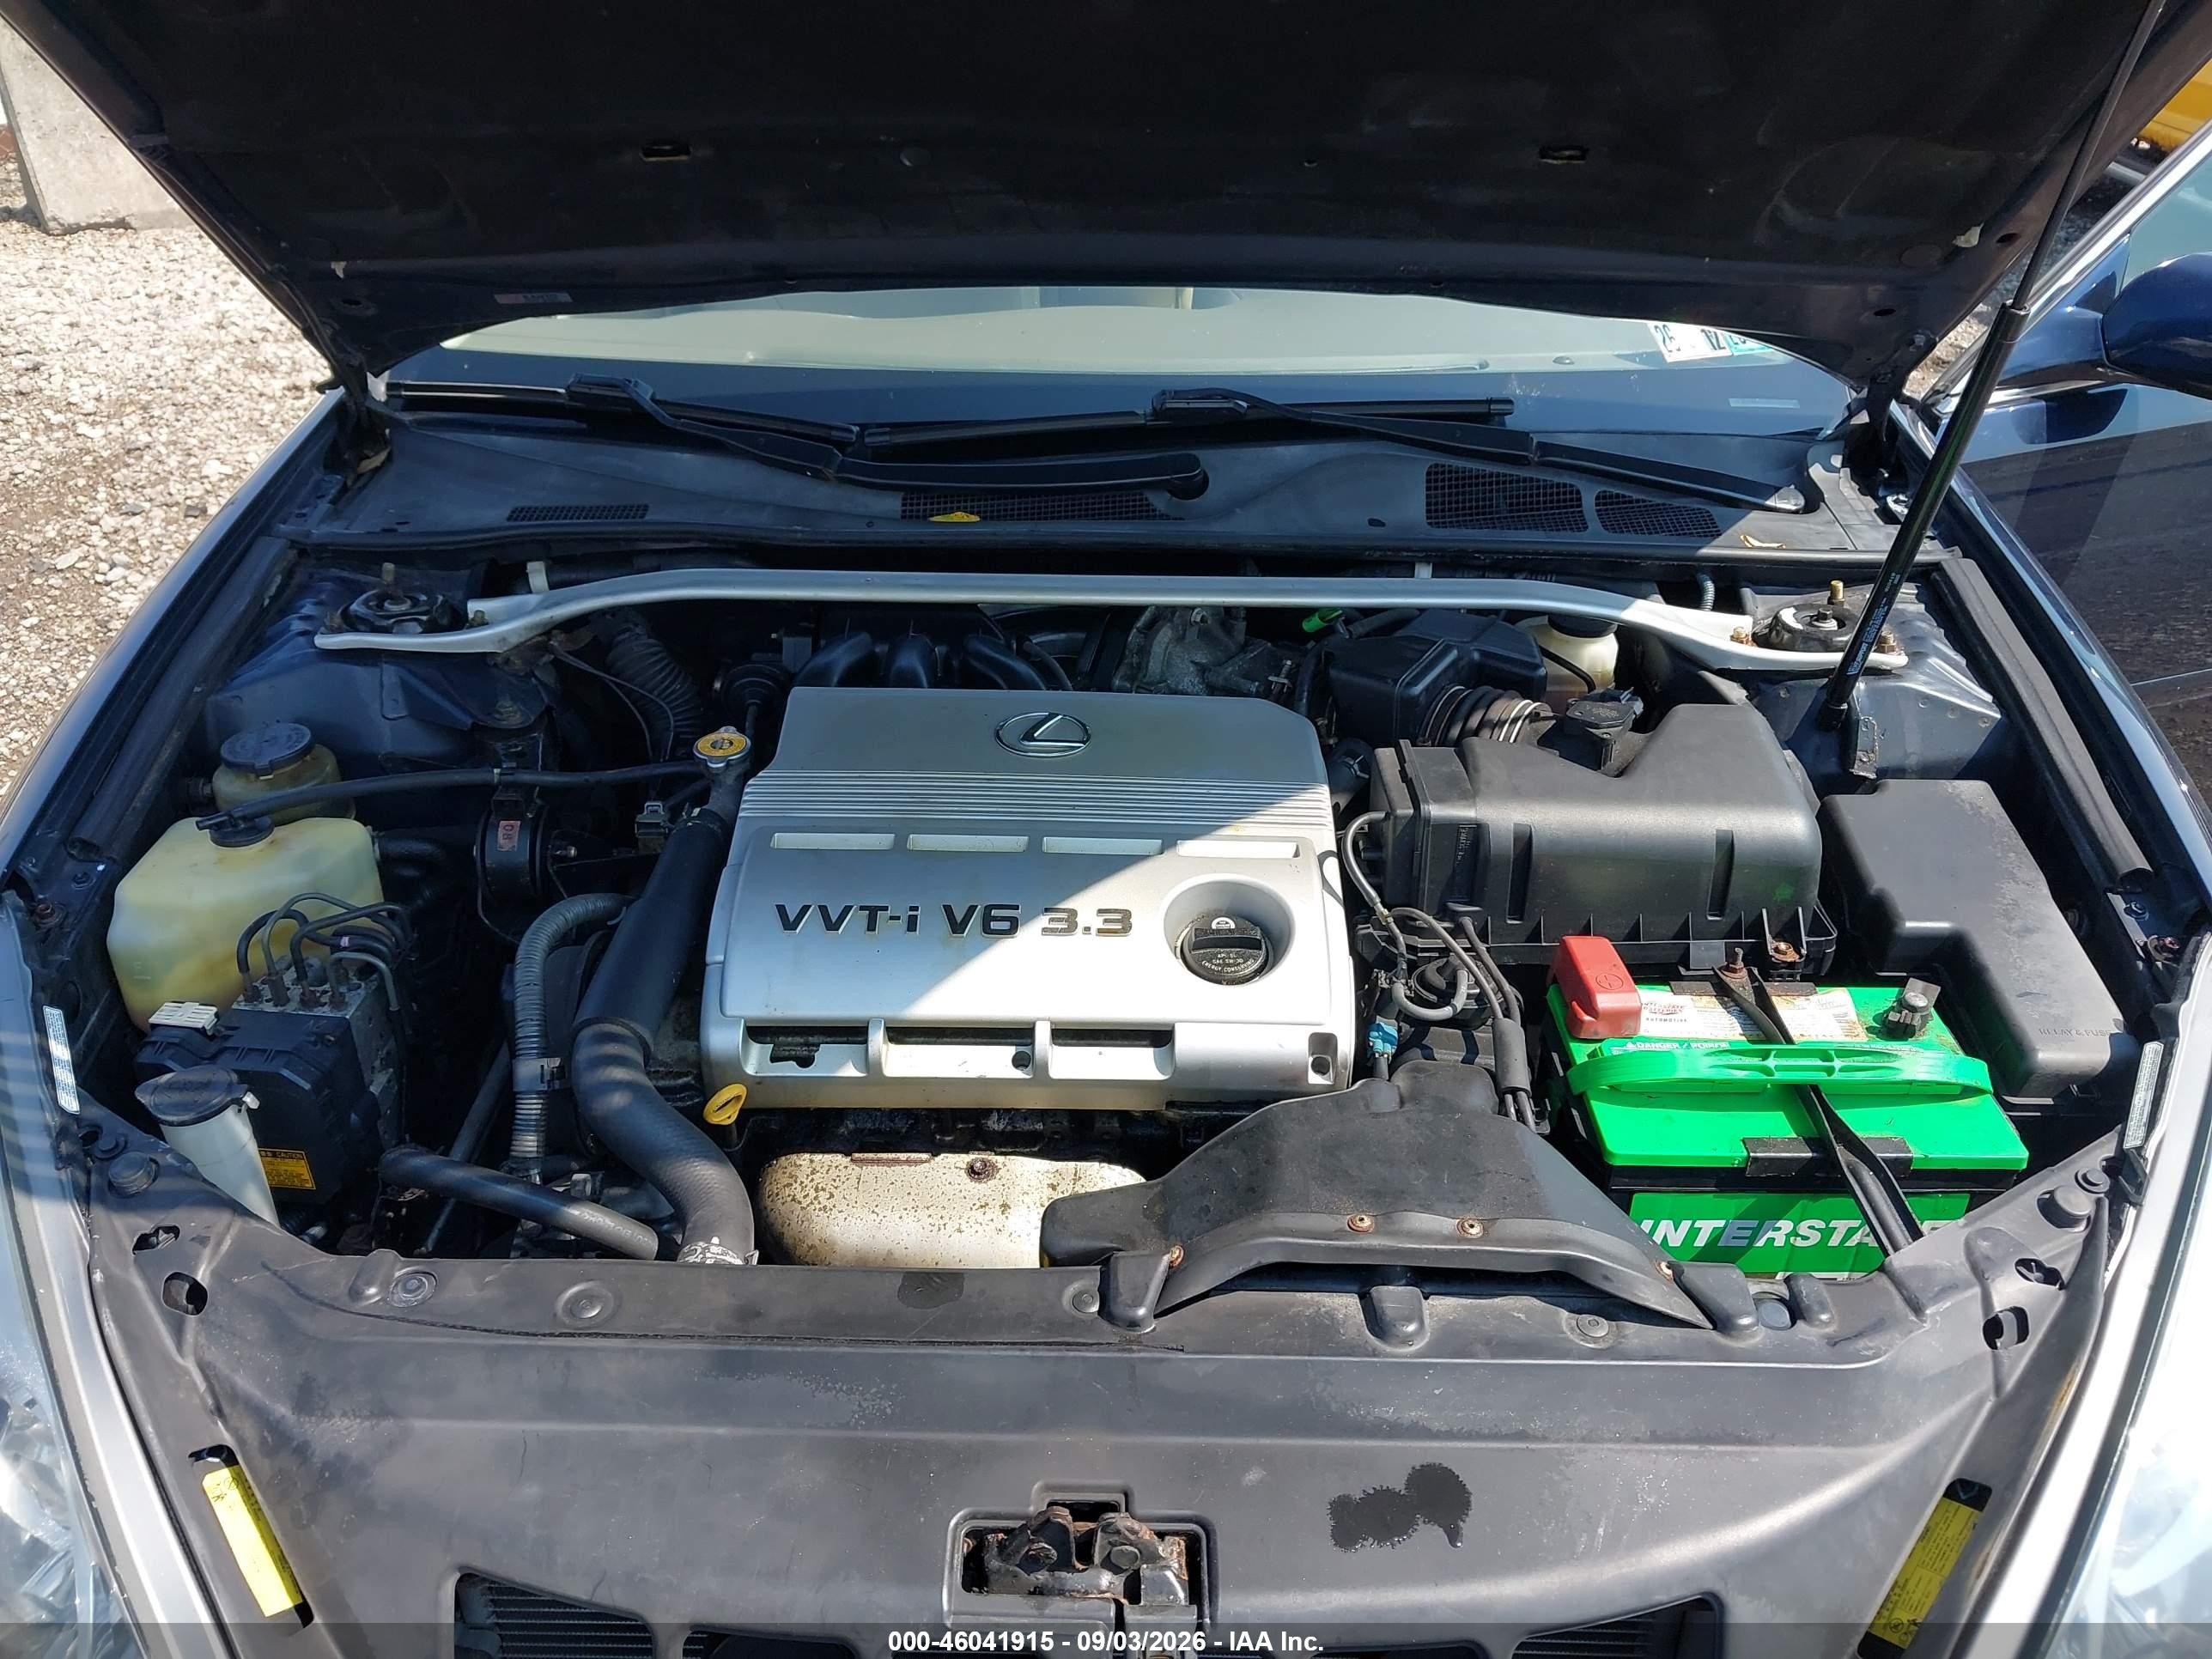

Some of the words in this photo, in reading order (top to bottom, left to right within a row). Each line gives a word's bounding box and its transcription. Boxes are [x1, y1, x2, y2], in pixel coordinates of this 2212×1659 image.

[775, 903, 921, 936] VVT-i
[942, 903, 1022, 939] V6
[1041, 905, 1133, 938] 3.3
[1201, 960, 1222, 971] ENERGY
